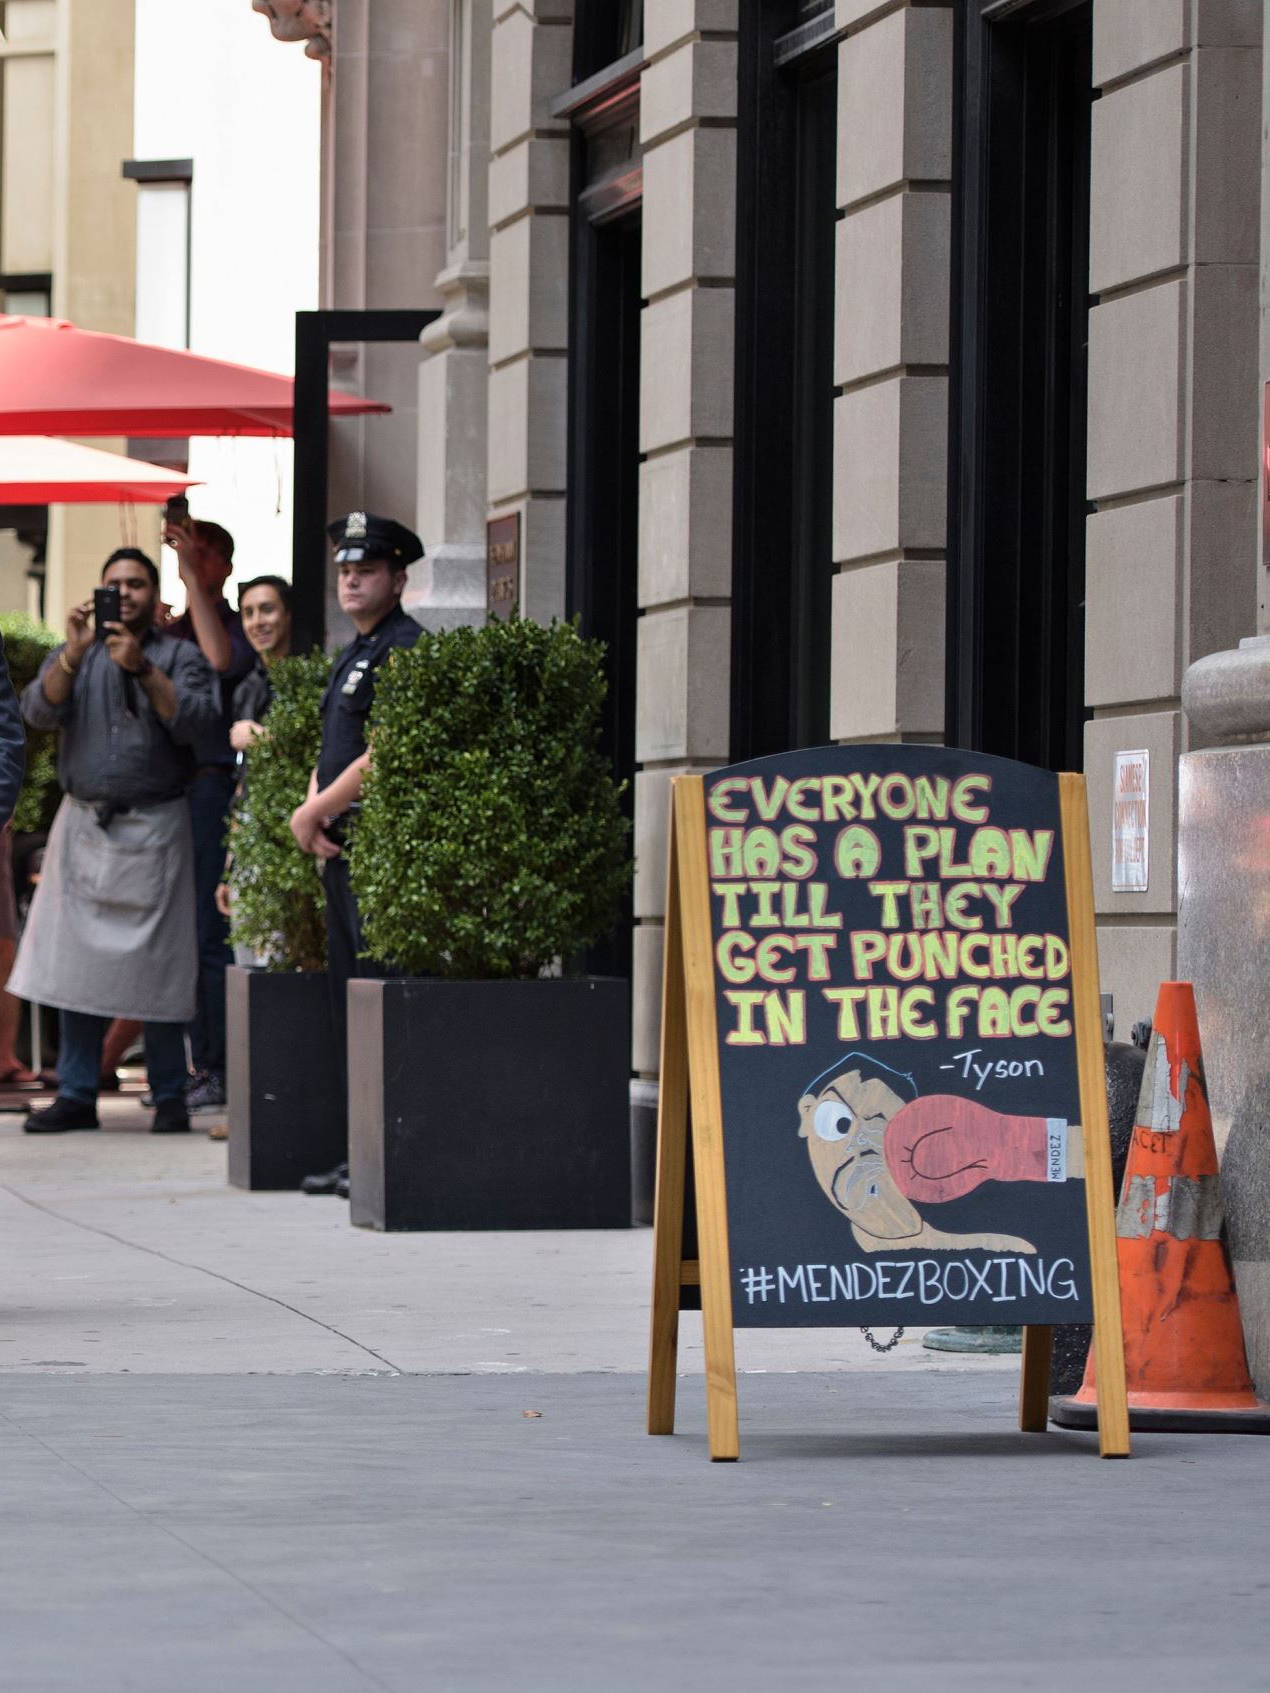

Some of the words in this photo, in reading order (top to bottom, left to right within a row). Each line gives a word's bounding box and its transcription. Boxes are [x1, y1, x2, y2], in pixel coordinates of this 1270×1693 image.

[708, 772, 993, 823] EVERYONE
[709, 824, 818, 879] HAS
[834, 824, 882, 879] A
[904, 825, 1054, 881] PLAN
[711, 880, 843, 929] TILL
[868, 880, 1026, 930] THEY
[716, 930, 837, 983] GET
[850, 930, 1070, 981] PUNCHED
[725, 989, 806, 1046] IN
[824, 986, 938, 1041] THE
[946, 985, 1073, 1039] FACE
[1050, 1135, 1061, 1180] MENDEZ
[740, 1258, 1079, 1304] #MENDEZBOXING
